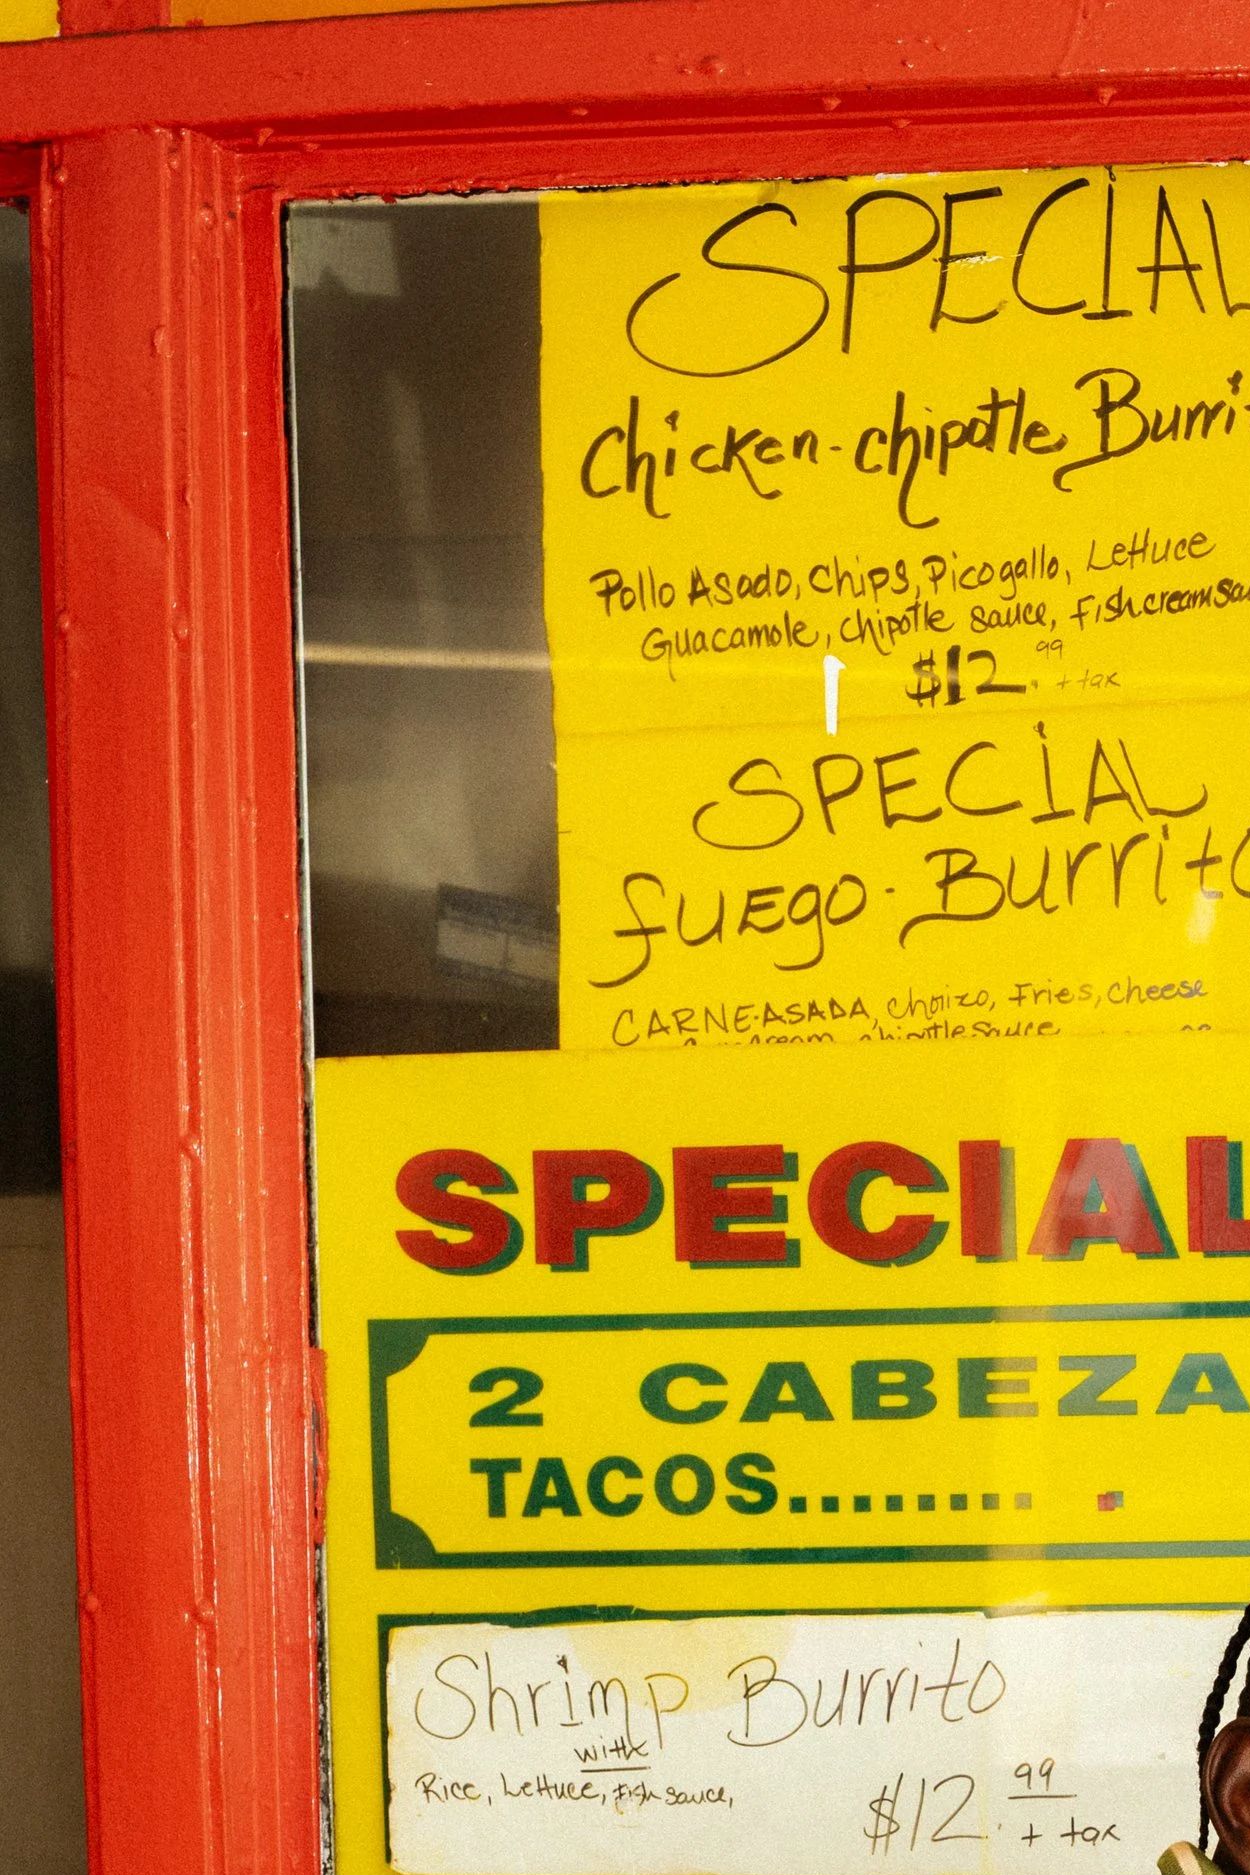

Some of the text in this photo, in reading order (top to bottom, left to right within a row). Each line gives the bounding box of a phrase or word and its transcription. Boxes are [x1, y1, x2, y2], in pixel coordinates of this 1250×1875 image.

[589, 566, 675, 617] Pollo
[688, 564, 801, 607] Asado,
[1086, 528, 1216, 572] Lettuce
[692, 721, 1208, 850] SPECIAL
[469, 1367, 543, 1427] 2
[415, 1636, 1006, 1749] Shrimp Burrito
[574, 1735, 649, 1762] with
